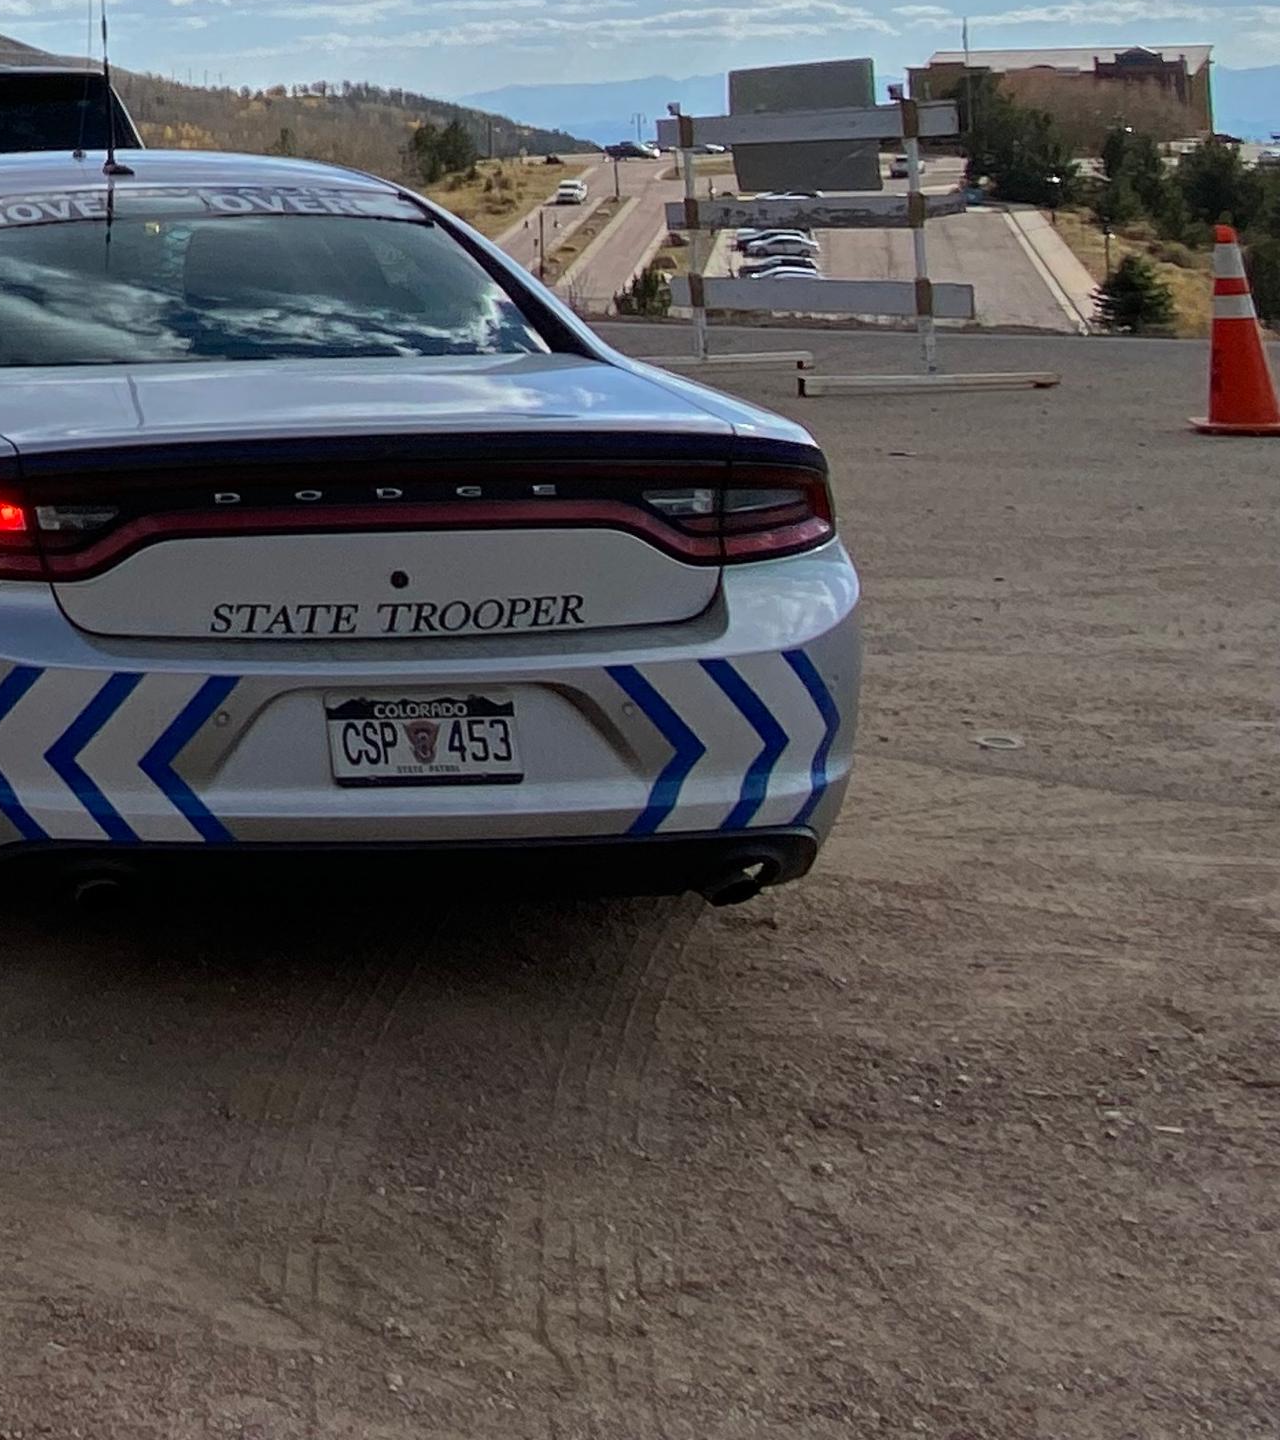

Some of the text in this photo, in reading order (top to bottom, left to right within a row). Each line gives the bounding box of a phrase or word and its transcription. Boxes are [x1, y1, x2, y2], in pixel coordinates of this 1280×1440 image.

[211, 194, 362, 215] OVER
[214, 484, 557, 504] DODGE
[210, 594, 585, 634] STATE TROOPER
[373, 703, 469, 718] COLORADO
[342, 719, 513, 765] CSP 453
